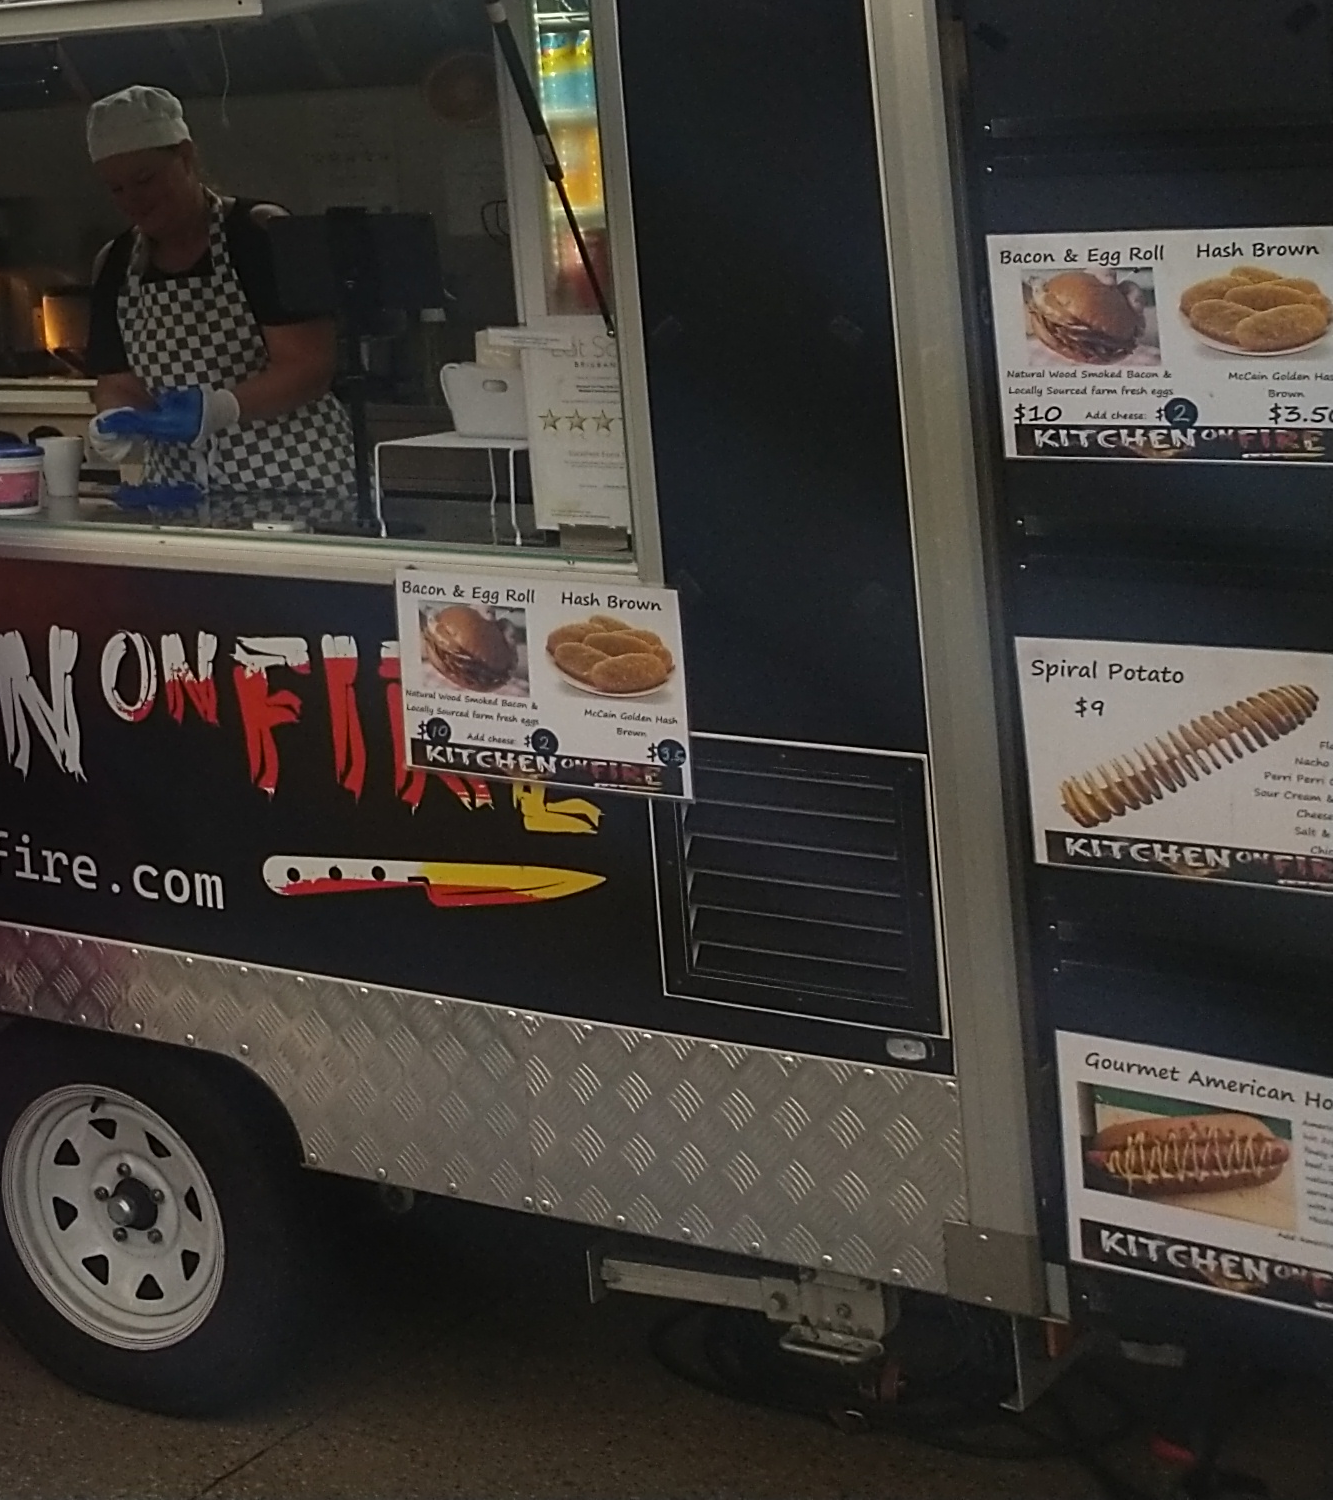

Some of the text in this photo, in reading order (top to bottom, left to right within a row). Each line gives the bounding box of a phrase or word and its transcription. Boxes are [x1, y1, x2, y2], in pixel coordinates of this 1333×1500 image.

[1000, 245, 1164, 266] Bacon & Egg Roll
[1196, 242, 1319, 259] Hash Brown
[1007, 370, 1045, 378] Natural
[1049, 370, 1077, 378] Wood
[1081, 370, 1122, 378] Smoked
[1127, 370, 1159, 378] Bacon
[1228, 371, 1268, 381] McCain
[1272, 371, 1310, 381] Golden
[1008, 386, 1174, 397] Locally Sourced farm fresh eggs
[1268, 389, 1305, 398] Brown
[1014, 403, 1062, 424] $10
[1085, 411, 1108, 420] Add
[1034, 428, 1196, 449] KITCHEN
[1238, 429, 1325, 451] FIRE
[402, 581, 537, 604] Bacon & Egg Roll
[561, 591, 663, 612] Hash Brown
[102, 630, 219, 727] ON
[1031, 658, 1184, 684] Spiral Potato
[405, 689, 436, 700] Natural
[438, 692, 461, 702] Wood
[465, 695, 498, 706] Smoked
[501, 699, 527, 709] Bacon
[1075, 697, 1105, 718] $9
[406, 703, 434, 716] Locally
[436, 707, 470, 718] Sourced
[473, 710, 494, 720] farm
[496, 712, 518, 723] fresh
[584, 708, 678, 725] McCain Golden Hash
[467, 733, 485, 742] Add
[616, 727, 647, 738] Brown
[426, 745, 557, 774] KITCHEN
[1295, 757, 1330, 767] Nacho
[1254, 787, 1280, 798] Sour
[1284, 791, 1322, 802] Cream
[1295, 826, 1316, 838] Salt
[1065, 836, 1230, 869] KITCHEN
[1085, 1051, 1181, 1082] Gourmet
[1188, 1070, 1295, 1103] American
[1100, 1229, 1270, 1284] KITCHEN
